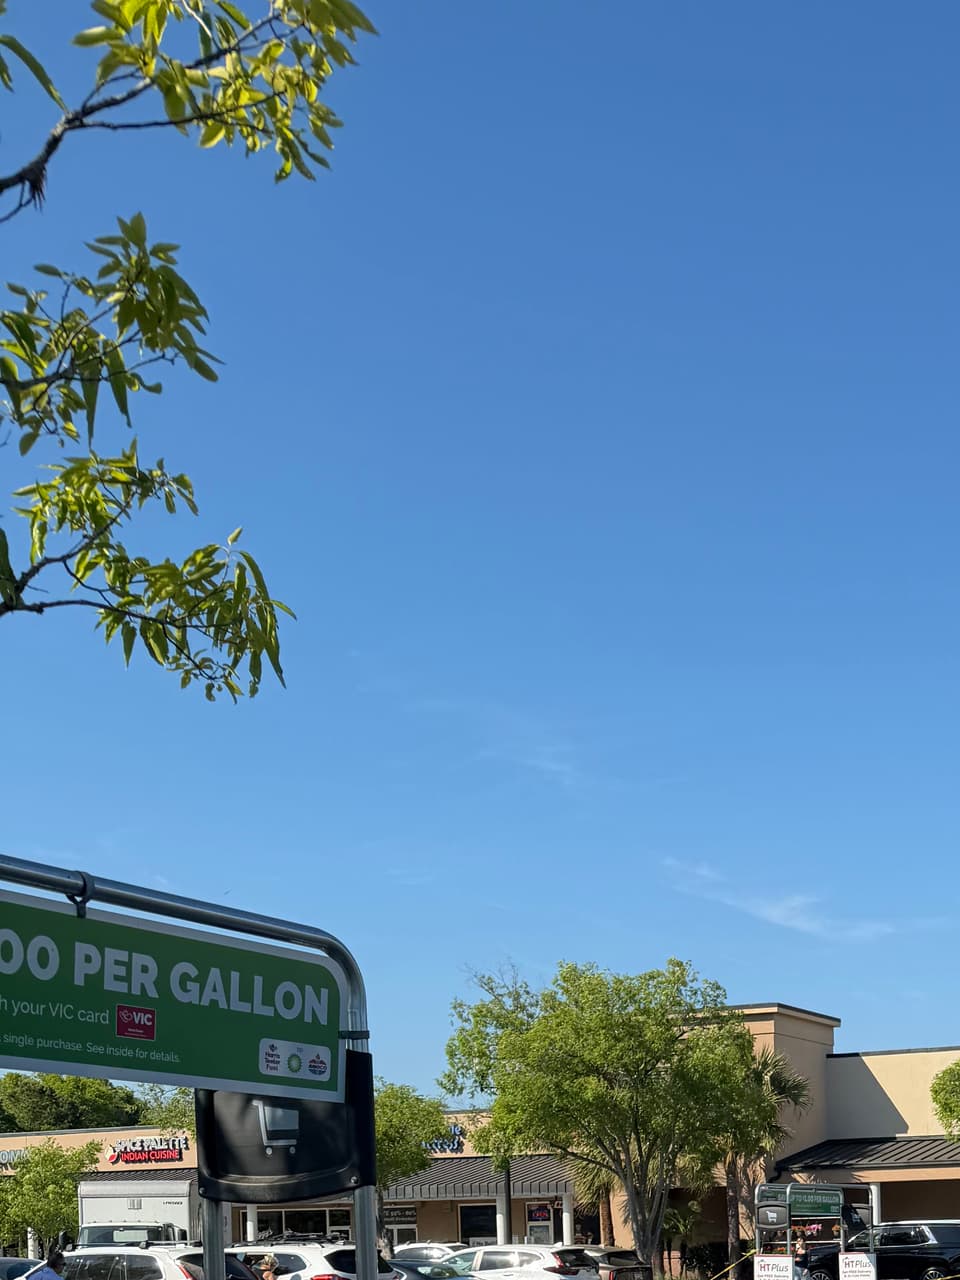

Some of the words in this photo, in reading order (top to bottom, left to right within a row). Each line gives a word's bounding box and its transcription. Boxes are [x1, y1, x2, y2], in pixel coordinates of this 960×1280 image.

[74, 941, 160, 998] PER
[170, 961, 329, 1026] GALLON
[12, 1000, 46, 1017] your
[49, 1002, 74, 1019] VIC
[77, 1009, 110, 1025] card
[132, 1011, 153, 1026] VIC
[3, 1033, 34, 1048] single
[86, 1042, 105, 1054] See
[106, 1046, 133, 1058] inside
[136, 1048, 149, 1059] for
[115, 1139, 143, 1152] SPICE
[143, 1135, 187, 1150] PALETTE
[121, 1151, 148, 1161] INDIAN
[149, 1149, 180, 1160] CUISINE
[759, 1263, 771, 1272] HT
